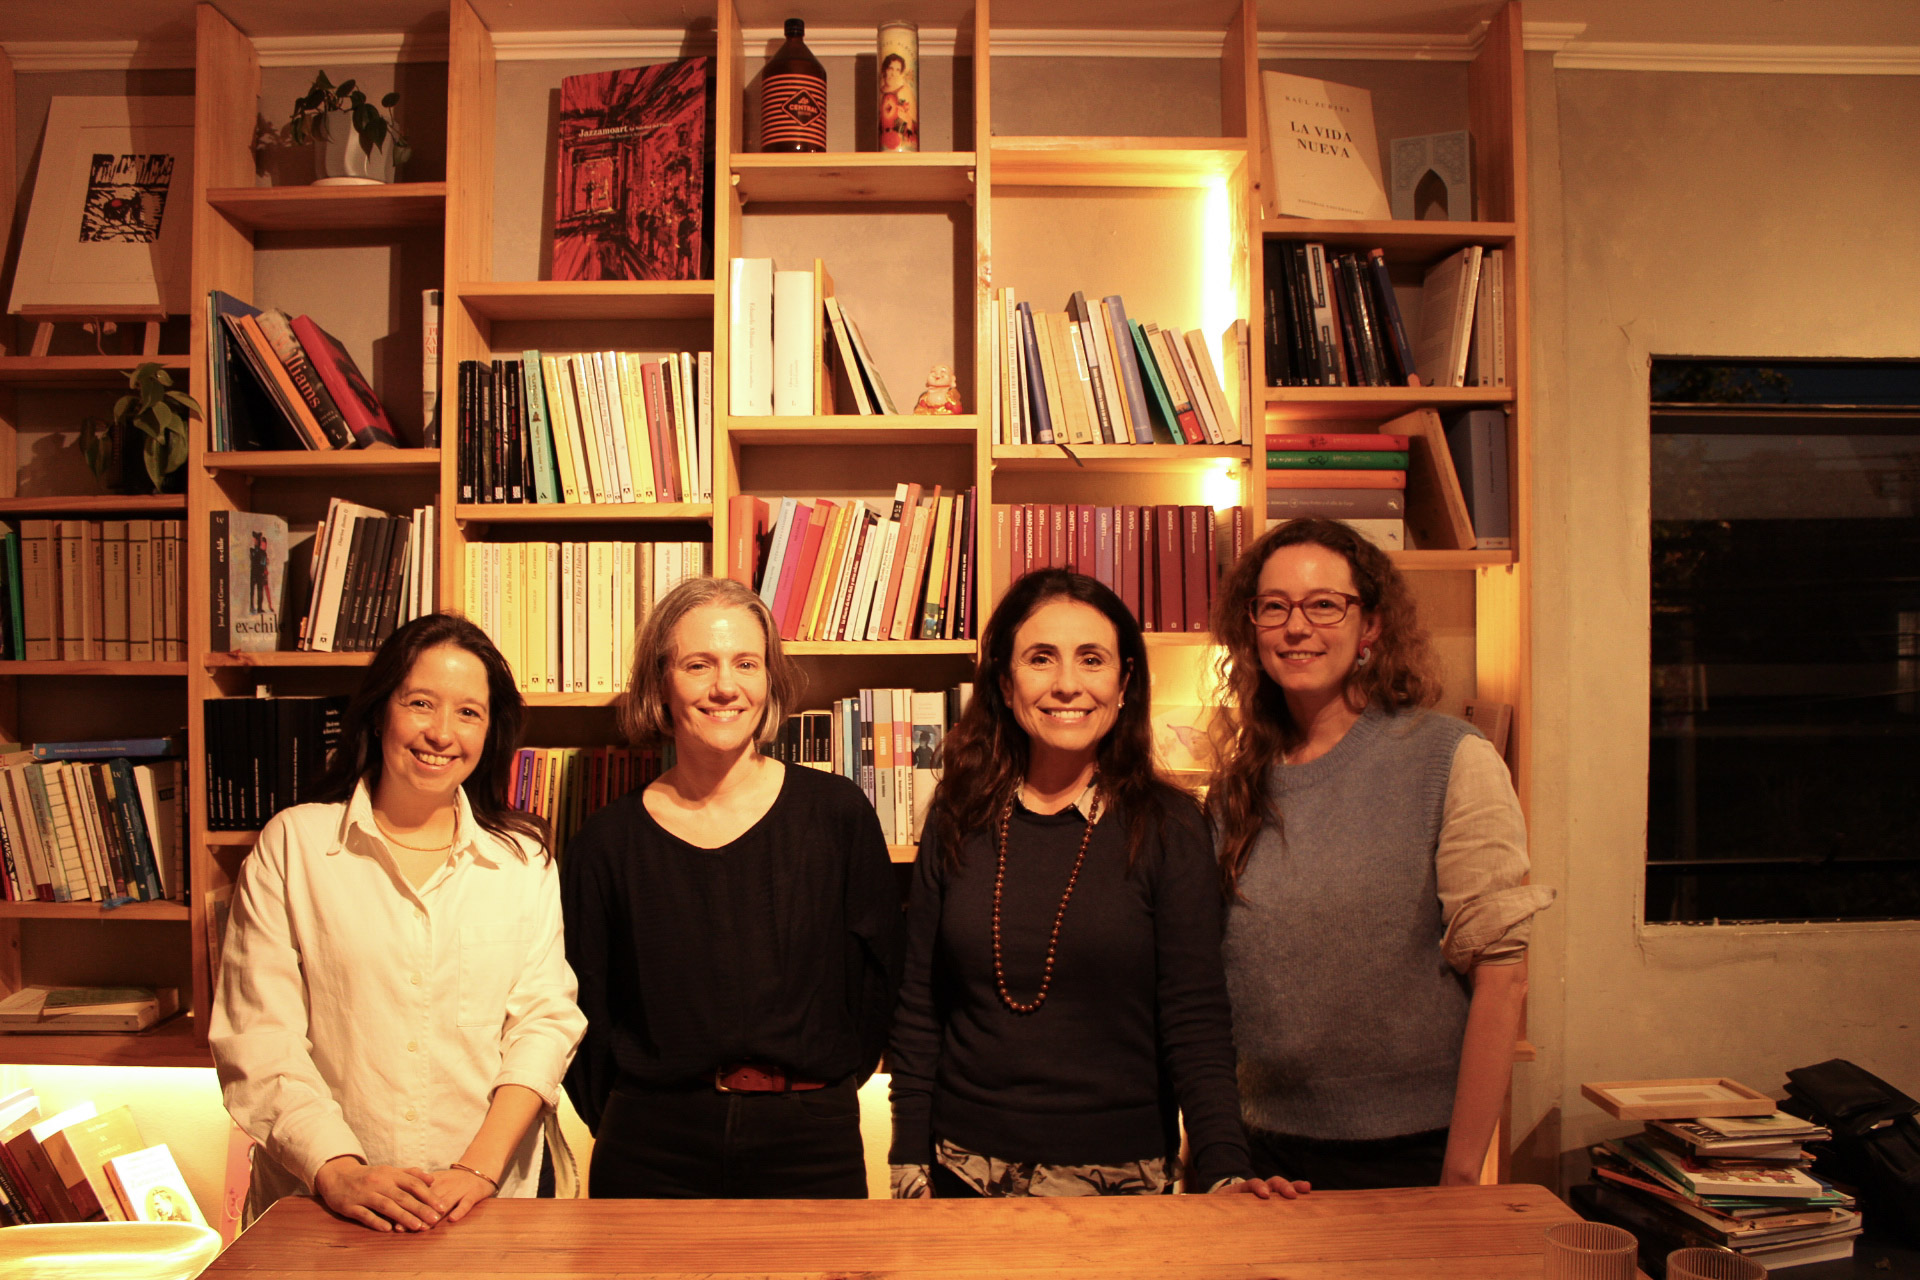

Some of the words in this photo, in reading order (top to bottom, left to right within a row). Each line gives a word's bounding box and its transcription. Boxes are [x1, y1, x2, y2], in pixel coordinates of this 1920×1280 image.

[788, 103, 818, 114] CENTRAL
[1315, 102, 1351, 113] ZURITA
[578, 125, 628, 138] Jazzamoart
[1291, 121, 1309, 135] LA
[1314, 126, 1352, 143] VIDA
[1297, 138, 1350, 158] NUEVA
[216, 537, 224, 562] ex-chile
[235, 612, 284, 635] ex-chile
